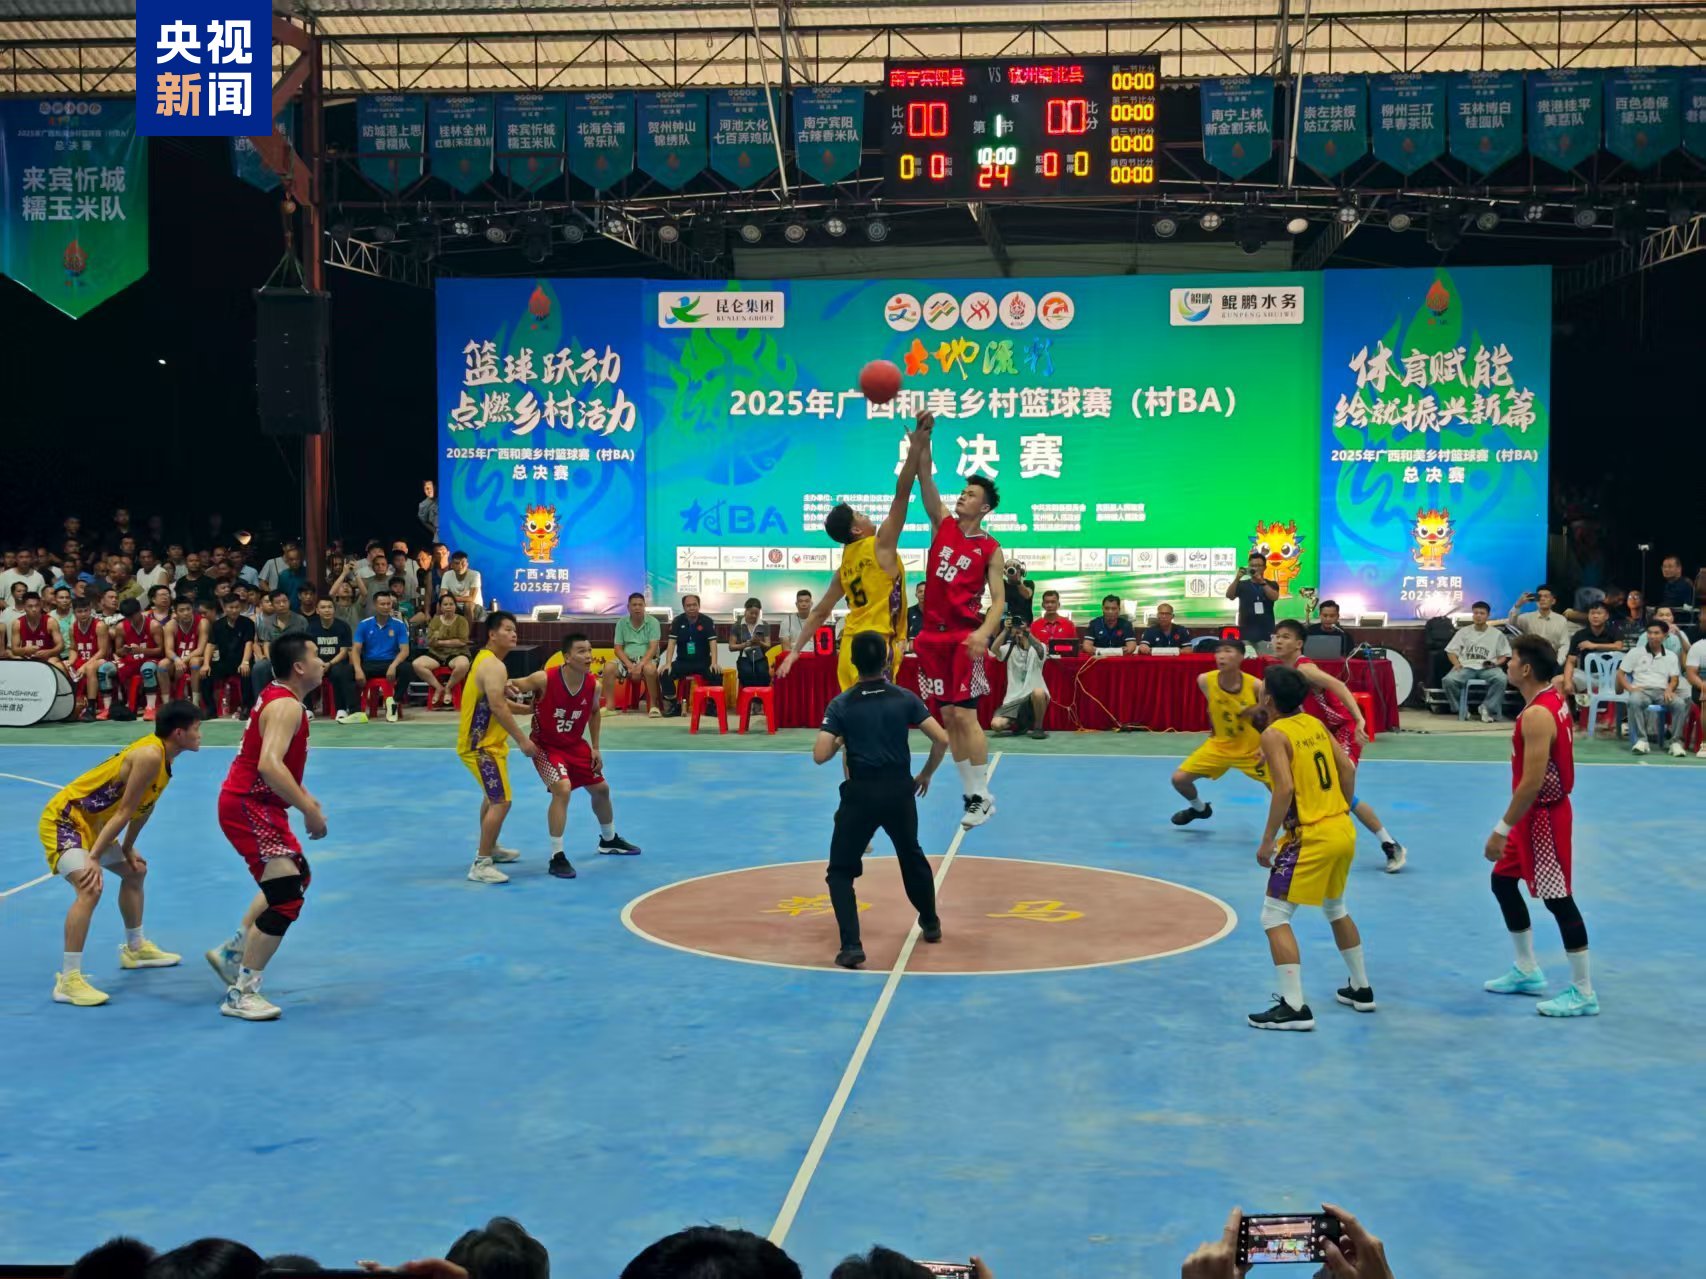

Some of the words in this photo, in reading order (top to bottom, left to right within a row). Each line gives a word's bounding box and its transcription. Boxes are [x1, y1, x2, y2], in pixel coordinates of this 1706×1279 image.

[988, 66, 1002, 83] VS
[1112, 72, 1154, 90] 00:00
[1047, 99, 1087, 135] 00
[1085, 101, 1099, 130] 比分
[1111, 103, 1154, 121] 00:00
[1211, 107, 1264, 122] 南宁上林
[1304, 104, 1357, 119] 崇左扶绥
[1382, 103, 1434, 117] 柳州三江
[1459, 101, 1512, 116] 玉林博白
[577, 122, 626, 135] 北海合浦
[648, 120, 696, 134] 贺州钟山
[719, 119, 768, 132] 河池大化
[803, 116, 853, 129] 南宁宾阳
[891, 105, 904, 136] 比分
[907, 102, 948, 138] 00
[362, 124, 422, 138] 防城港上思
[439, 123, 487, 138] 桂林全州
[507, 123, 556, 136] 来宾忻城
[713, 132, 775, 145] 七百弄鸡队
[798, 129, 860, 143] 古辣香米队
[584, 135, 620, 148] 常乐队
[1110, 134, 1154, 152] 00:00
[976, 147, 1018, 165] 10:00
[1043, 151, 1058, 177] 0
[1074, 151, 1089, 177] 0
[900, 154, 915, 180] 0
[930, 153, 945, 179] 0
[1110, 166, 1154, 184] 00:00
[22, 166, 126, 193] 来宾忻城
[977, 165, 1010, 189] 24
[22, 195, 126, 222] 糯玉米队
[716, 298, 774, 314] 昆仑集团
[1221, 293, 1297, 310] 鲲鹏水务
[462, 339, 621, 388] 篮球跃动
[1348, 340, 1514, 393] 体育赋能
[448, 388, 636, 436] 点燃乡村活力
[1333, 386, 1537, 433] 绘就振兴新篇
[512, 464, 569, 481] 总决赛
[1402, 466, 1465, 483] 总决赛
[935, 561, 958, 582] 28
[513, 582, 571, 593] 2025年7月
[80, 650, 91, 661] 33
[926, 678, 945, 696] 28
[556, 719, 574, 733] 25
[1314, 751, 1332, 791] 0
